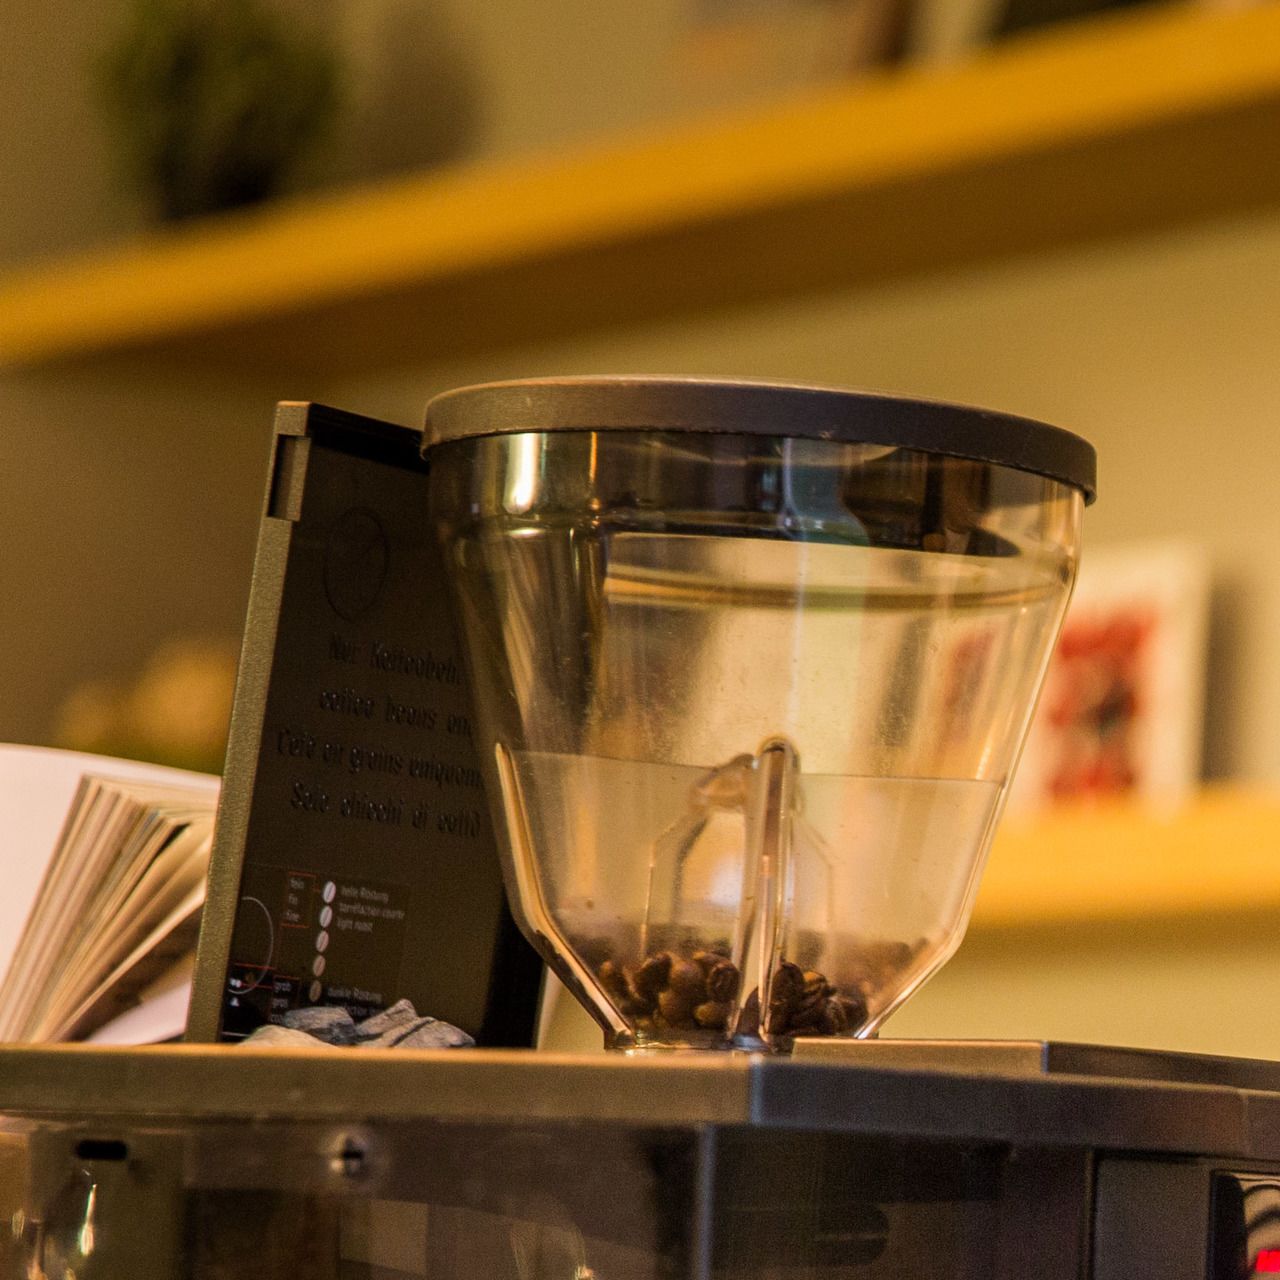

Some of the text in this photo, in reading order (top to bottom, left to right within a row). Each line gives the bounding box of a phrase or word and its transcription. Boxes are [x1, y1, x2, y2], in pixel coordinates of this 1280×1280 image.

[318, 687, 375, 720] coffee
[384, 694, 438, 731] beans
[348, 745, 404, 776] grains
[289, 781, 330, 814] Solo
